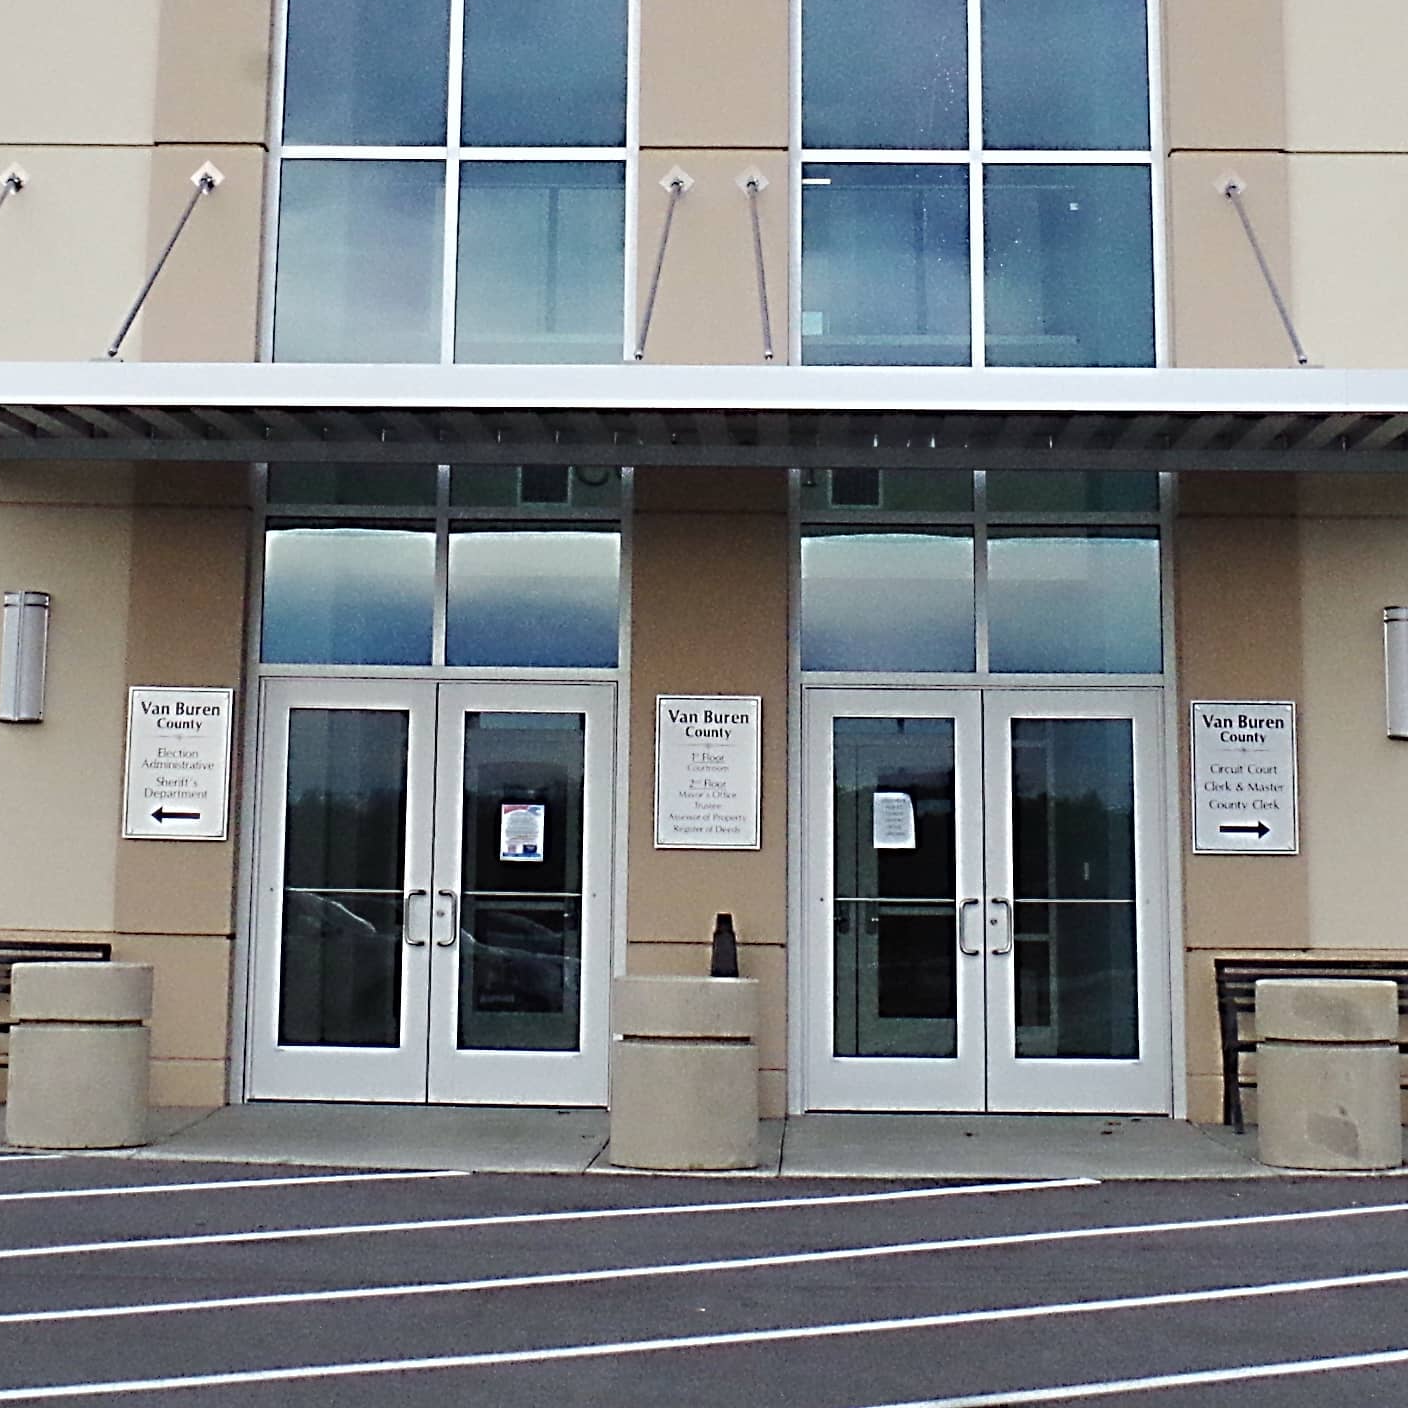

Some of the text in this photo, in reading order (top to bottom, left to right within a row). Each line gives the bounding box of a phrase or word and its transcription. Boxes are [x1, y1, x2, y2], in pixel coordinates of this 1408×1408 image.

[141, 701, 220, 716] Van Buren
[668, 709, 749, 724] Van Buren
[1202, 714, 1284, 729] Van Buren
[157, 718, 202, 732] County
[685, 726, 732, 740] County
[1220, 731, 1266, 743] County
[158, 747, 199, 758] Election
[1210, 763, 1277, 775] Circuit Court
[1204, 781, 1284, 792] Clerk & Master
[144, 788, 208, 800] Department
[1209, 799, 1280, 811] County Clerk
